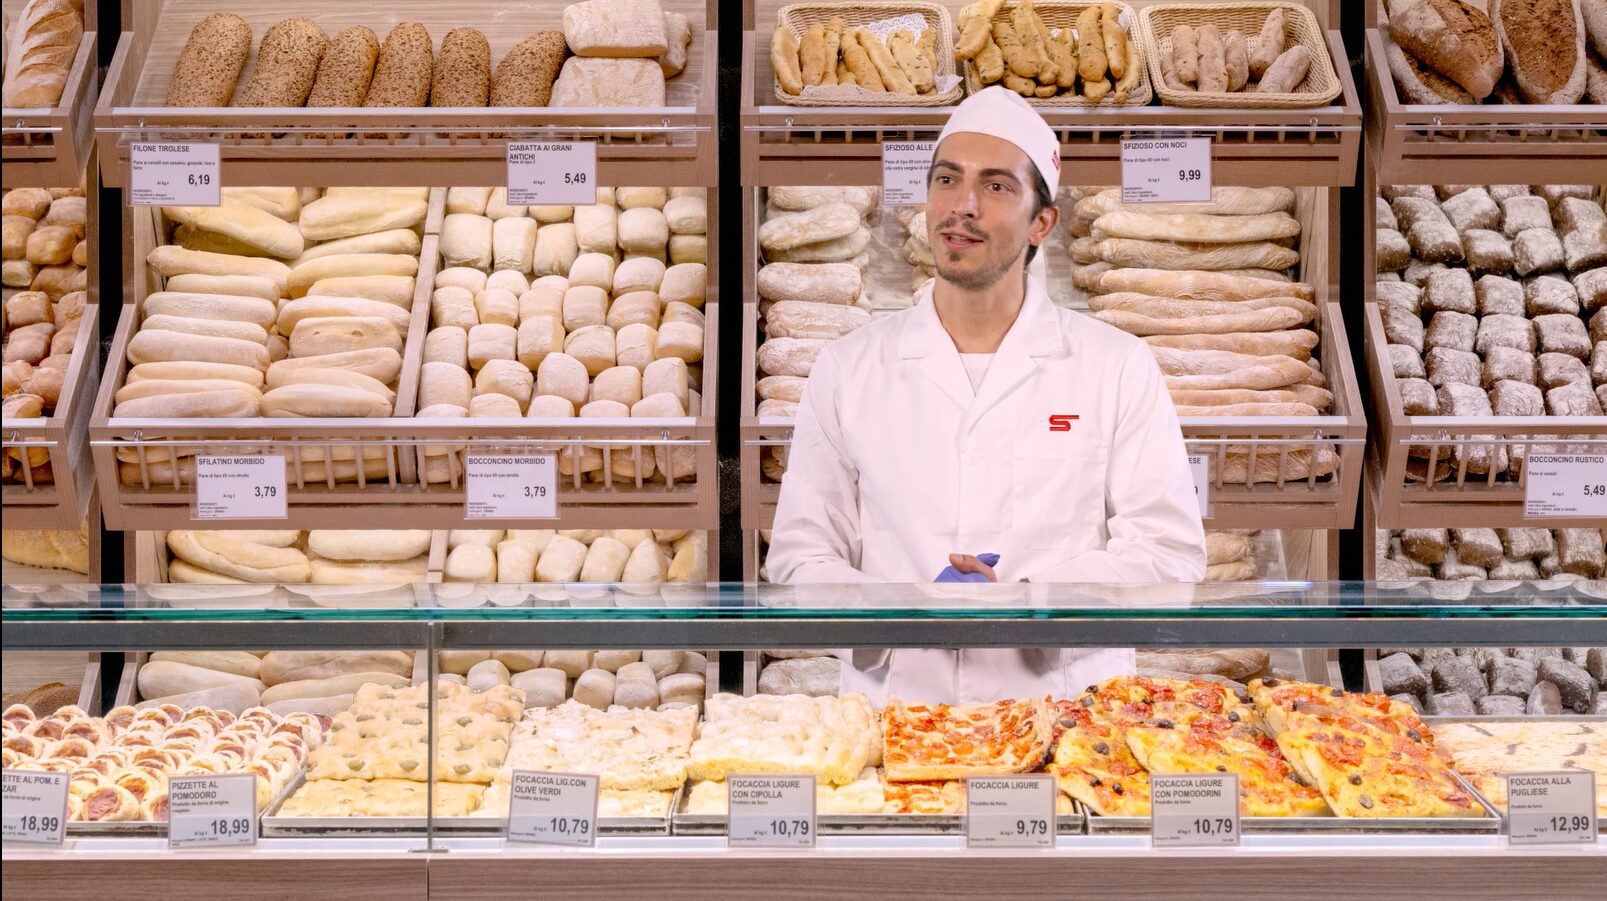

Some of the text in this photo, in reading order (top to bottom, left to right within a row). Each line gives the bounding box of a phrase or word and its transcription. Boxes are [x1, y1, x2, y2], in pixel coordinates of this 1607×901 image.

[158, 145, 190, 153] TIROLESE
[1123, 142, 1154, 150] SFIZIOSO
[1170, 141, 1187, 149] NOCI
[188, 174, 210, 186] 6,19
[564, 173, 586, 185] 5,49
[1179, 169, 1201, 182] 9,99
[254, 486, 276, 498] 3,79
[524, 486, 546, 498] 3,79
[1584, 485, 1606, 497] 5,49
[2, 774, 21, 783] ETTE
[34, 776, 52, 784] POM.
[516, 775, 586, 787] FOCACCIA LIG.CON
[732, 780, 771, 788] FOCACCIA
[1154, 780, 1193, 788] FOCACCIA
[1510, 778, 1550, 786] FOCACCIA
[2, 784, 16, 792] ZAR
[172, 781, 207, 790] PIZZETTE
[514, 785, 562, 796] OLIVE VERDI
[970, 781, 1039, 790] FOCACCIA LIGURE
[172, 791, 217, 800] POMODORO
[750, 790, 782, 798] CIPOLLA
[1172, 790, 1222, 798] POMODORINI
[1510, 788, 1548, 796] PUGLIESE
[20, 816, 59, 834] 18,99
[211, 818, 250, 837] 18,99
[550, 817, 589, 836] 10,79
[770, 820, 809, 838] 10,79
[1016, 820, 1048, 837] 9,79
[1194, 818, 1232, 836] 10,79
[1550, 816, 1590, 834] 12,99
